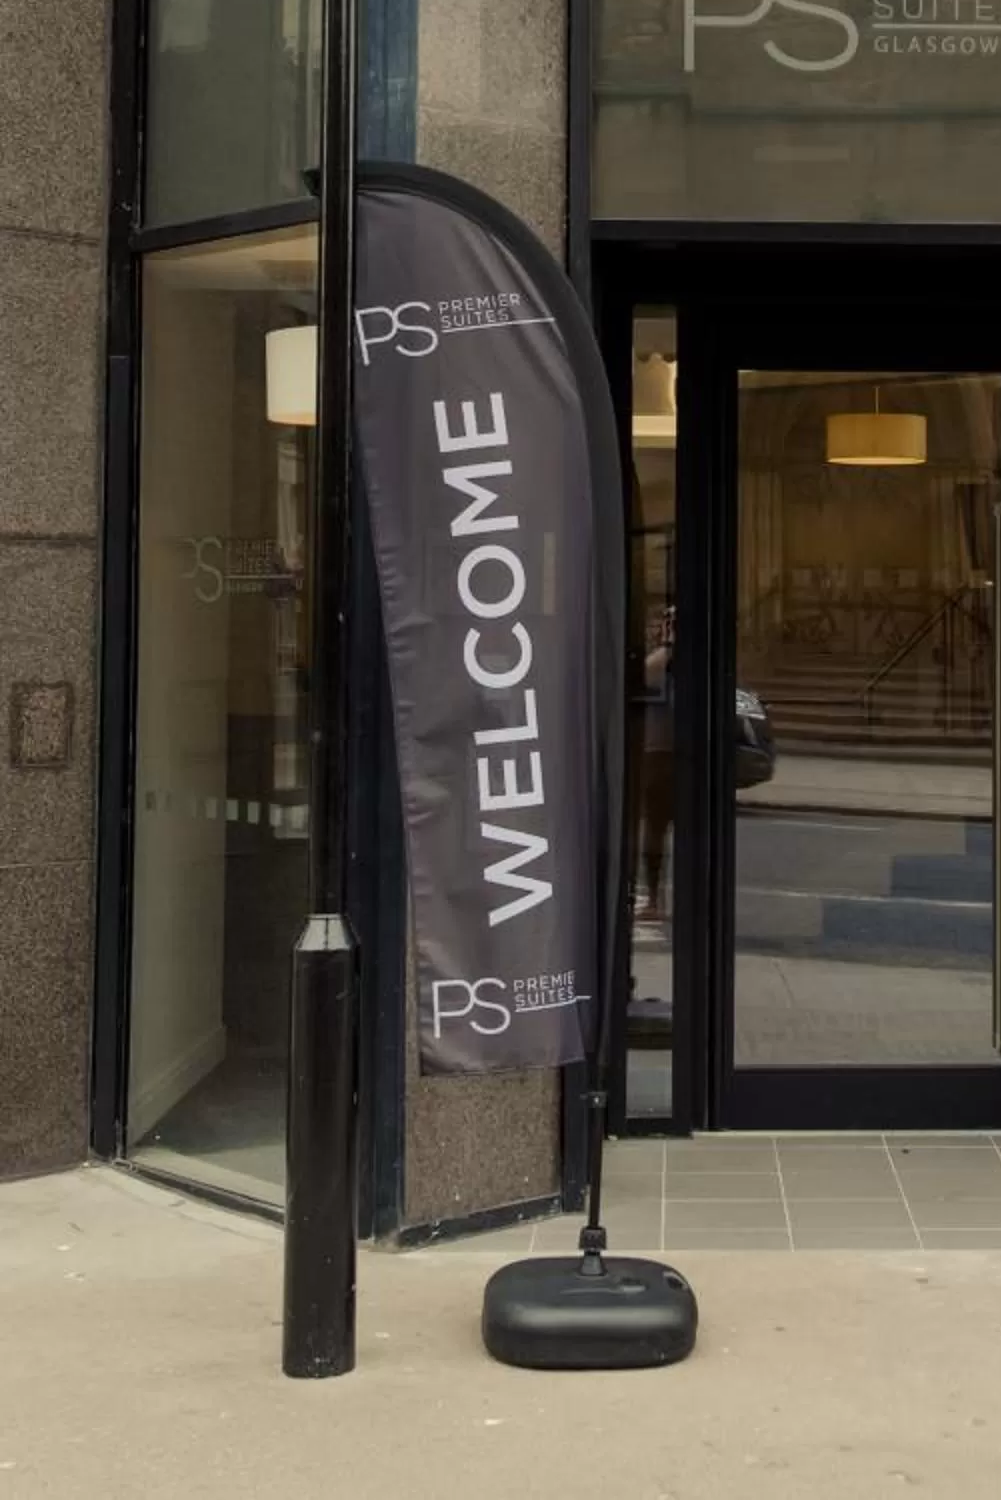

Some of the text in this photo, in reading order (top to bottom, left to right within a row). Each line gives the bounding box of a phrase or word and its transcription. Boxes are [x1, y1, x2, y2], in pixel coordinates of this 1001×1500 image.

[873, 35, 1001, 55] GLASGOW
[437, 292, 521, 314] PREMIER
[440, 308, 510, 329] SUITES
[354, 300, 439, 367] PS
[433, 391, 553, 928] WELCOME
[513, 969, 576, 993] PREMIE
[431, 976, 511, 1040] PS
[514, 985, 575, 1008] SUITES
